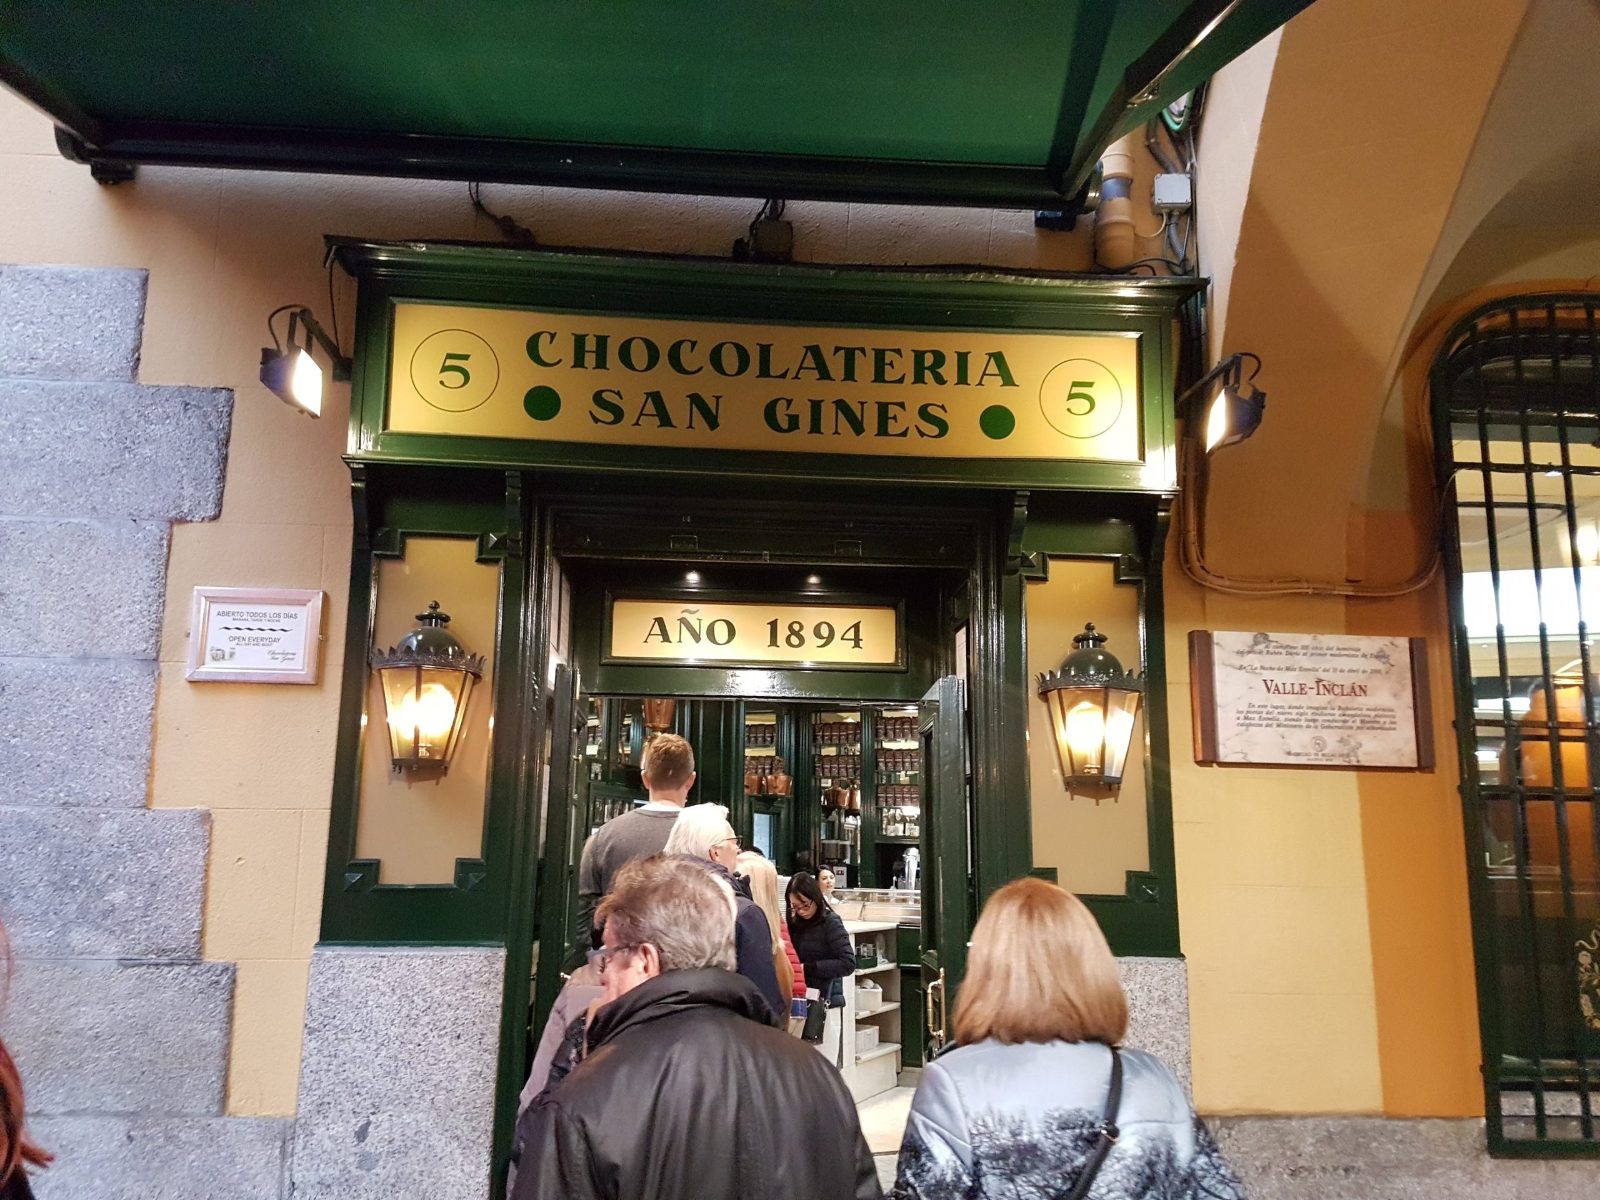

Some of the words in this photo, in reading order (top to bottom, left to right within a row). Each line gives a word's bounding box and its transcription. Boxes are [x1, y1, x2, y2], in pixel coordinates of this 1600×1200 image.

[438, 352, 472, 390] 5
[525, 330, 1020, 388] CHOCOLATERIA
[589, 388, 723, 432] SAN
[763, 397, 950, 439] GINES
[1065, 380, 1097, 416] 5
[216, 610, 245, 618] ABIERTO
[643, 608, 737, 646] AÑO
[766, 618, 864, 650] 1894
[228, 635, 247, 643] OPEN
[247, 636, 282, 644] EVERYDAY
